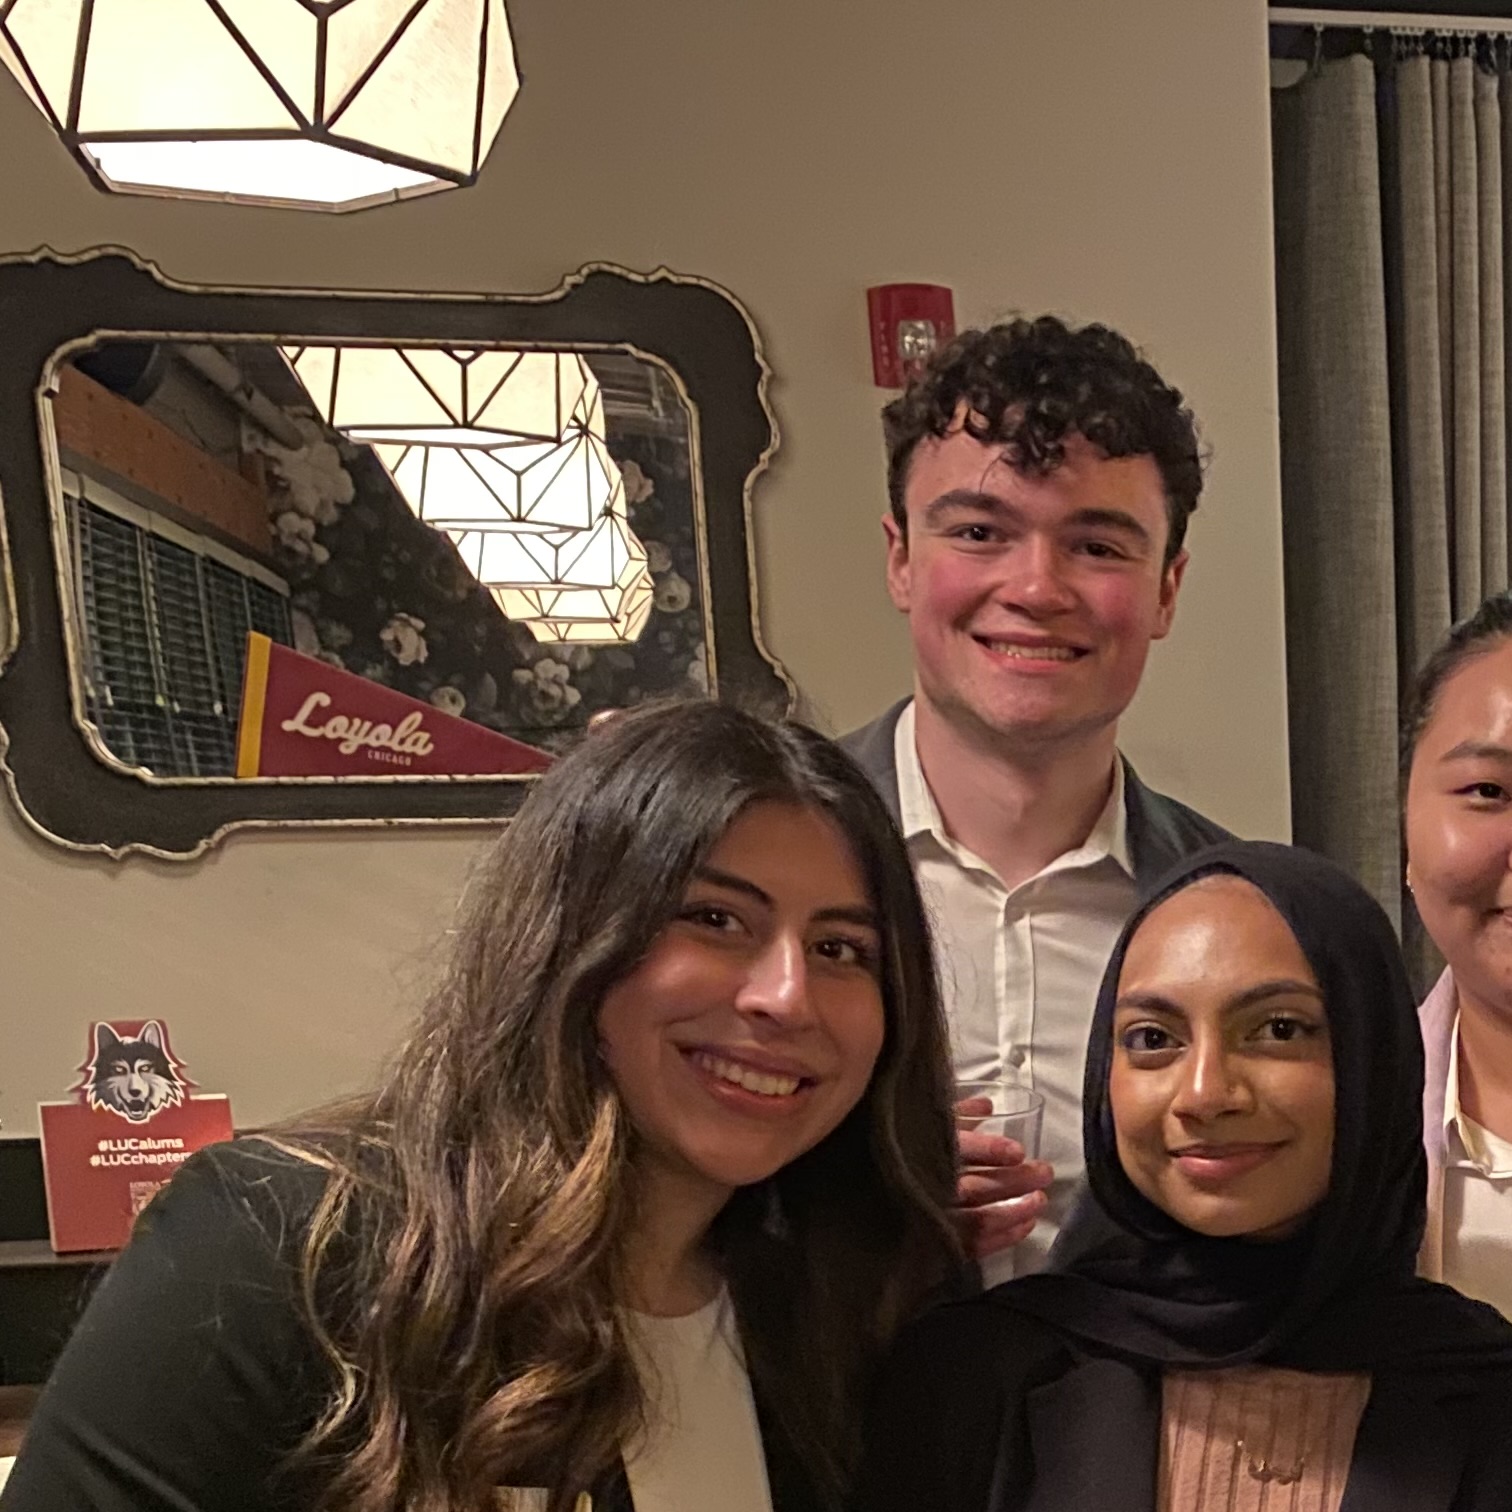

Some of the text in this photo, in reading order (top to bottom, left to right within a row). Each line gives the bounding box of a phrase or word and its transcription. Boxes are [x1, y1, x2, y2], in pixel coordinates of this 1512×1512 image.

[281, 691, 434, 756] Loyola
[367, 750, 411, 766] CHICAGO
[98, 1137, 184, 1151] #LUCalums
